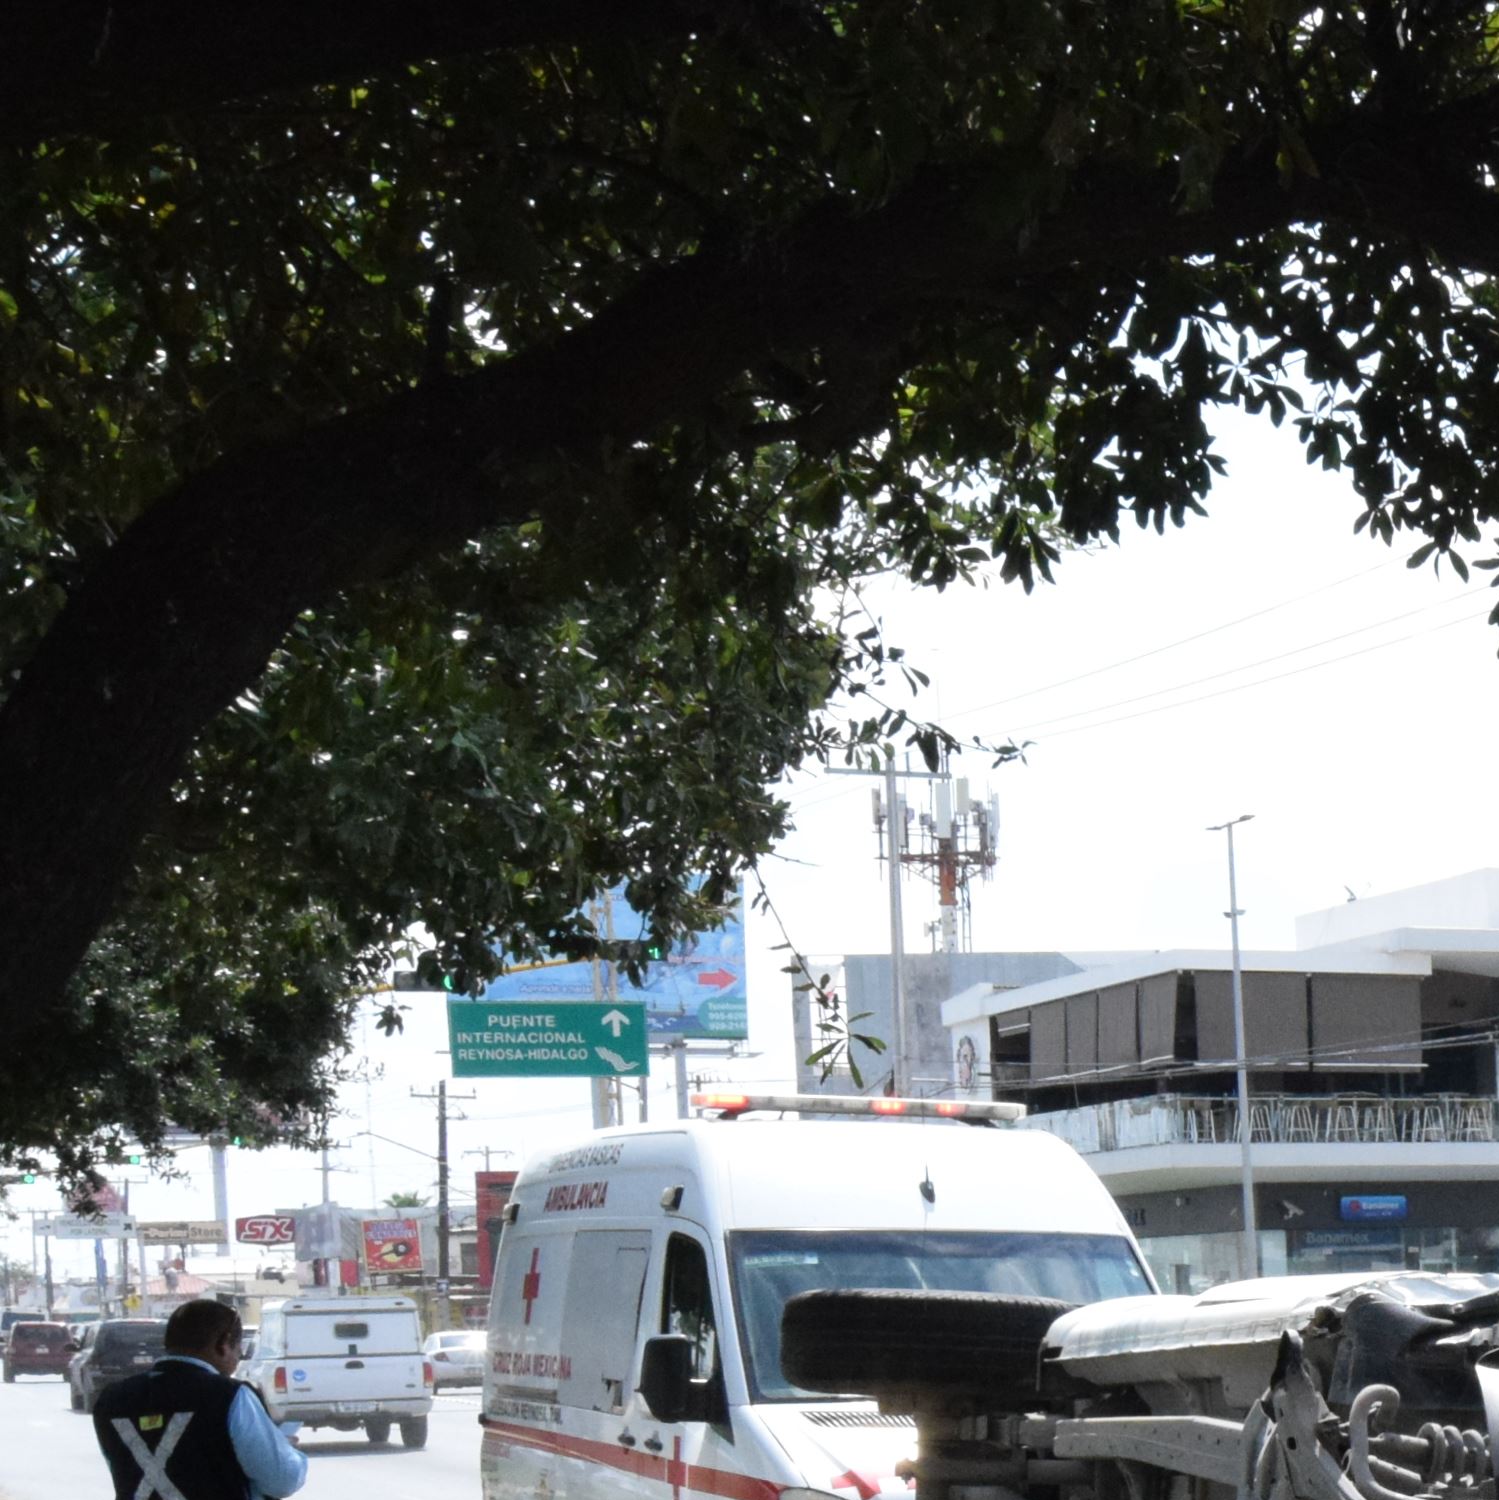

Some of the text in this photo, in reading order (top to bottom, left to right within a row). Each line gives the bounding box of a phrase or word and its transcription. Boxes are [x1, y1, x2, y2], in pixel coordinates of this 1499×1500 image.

[488, 1014, 555, 1027] PUENTE
[457, 1032, 585, 1045] INTERNACIONAL
[458, 1048, 588, 1061] REYNOSA-HIDALGO
[544, 1181, 609, 1212] AMBULANCIA
[190, 1226, 222, 1237] Store
[1306, 1232, 1369, 1244] Banamex
[533, 1354, 572, 1380] MEXICANA
